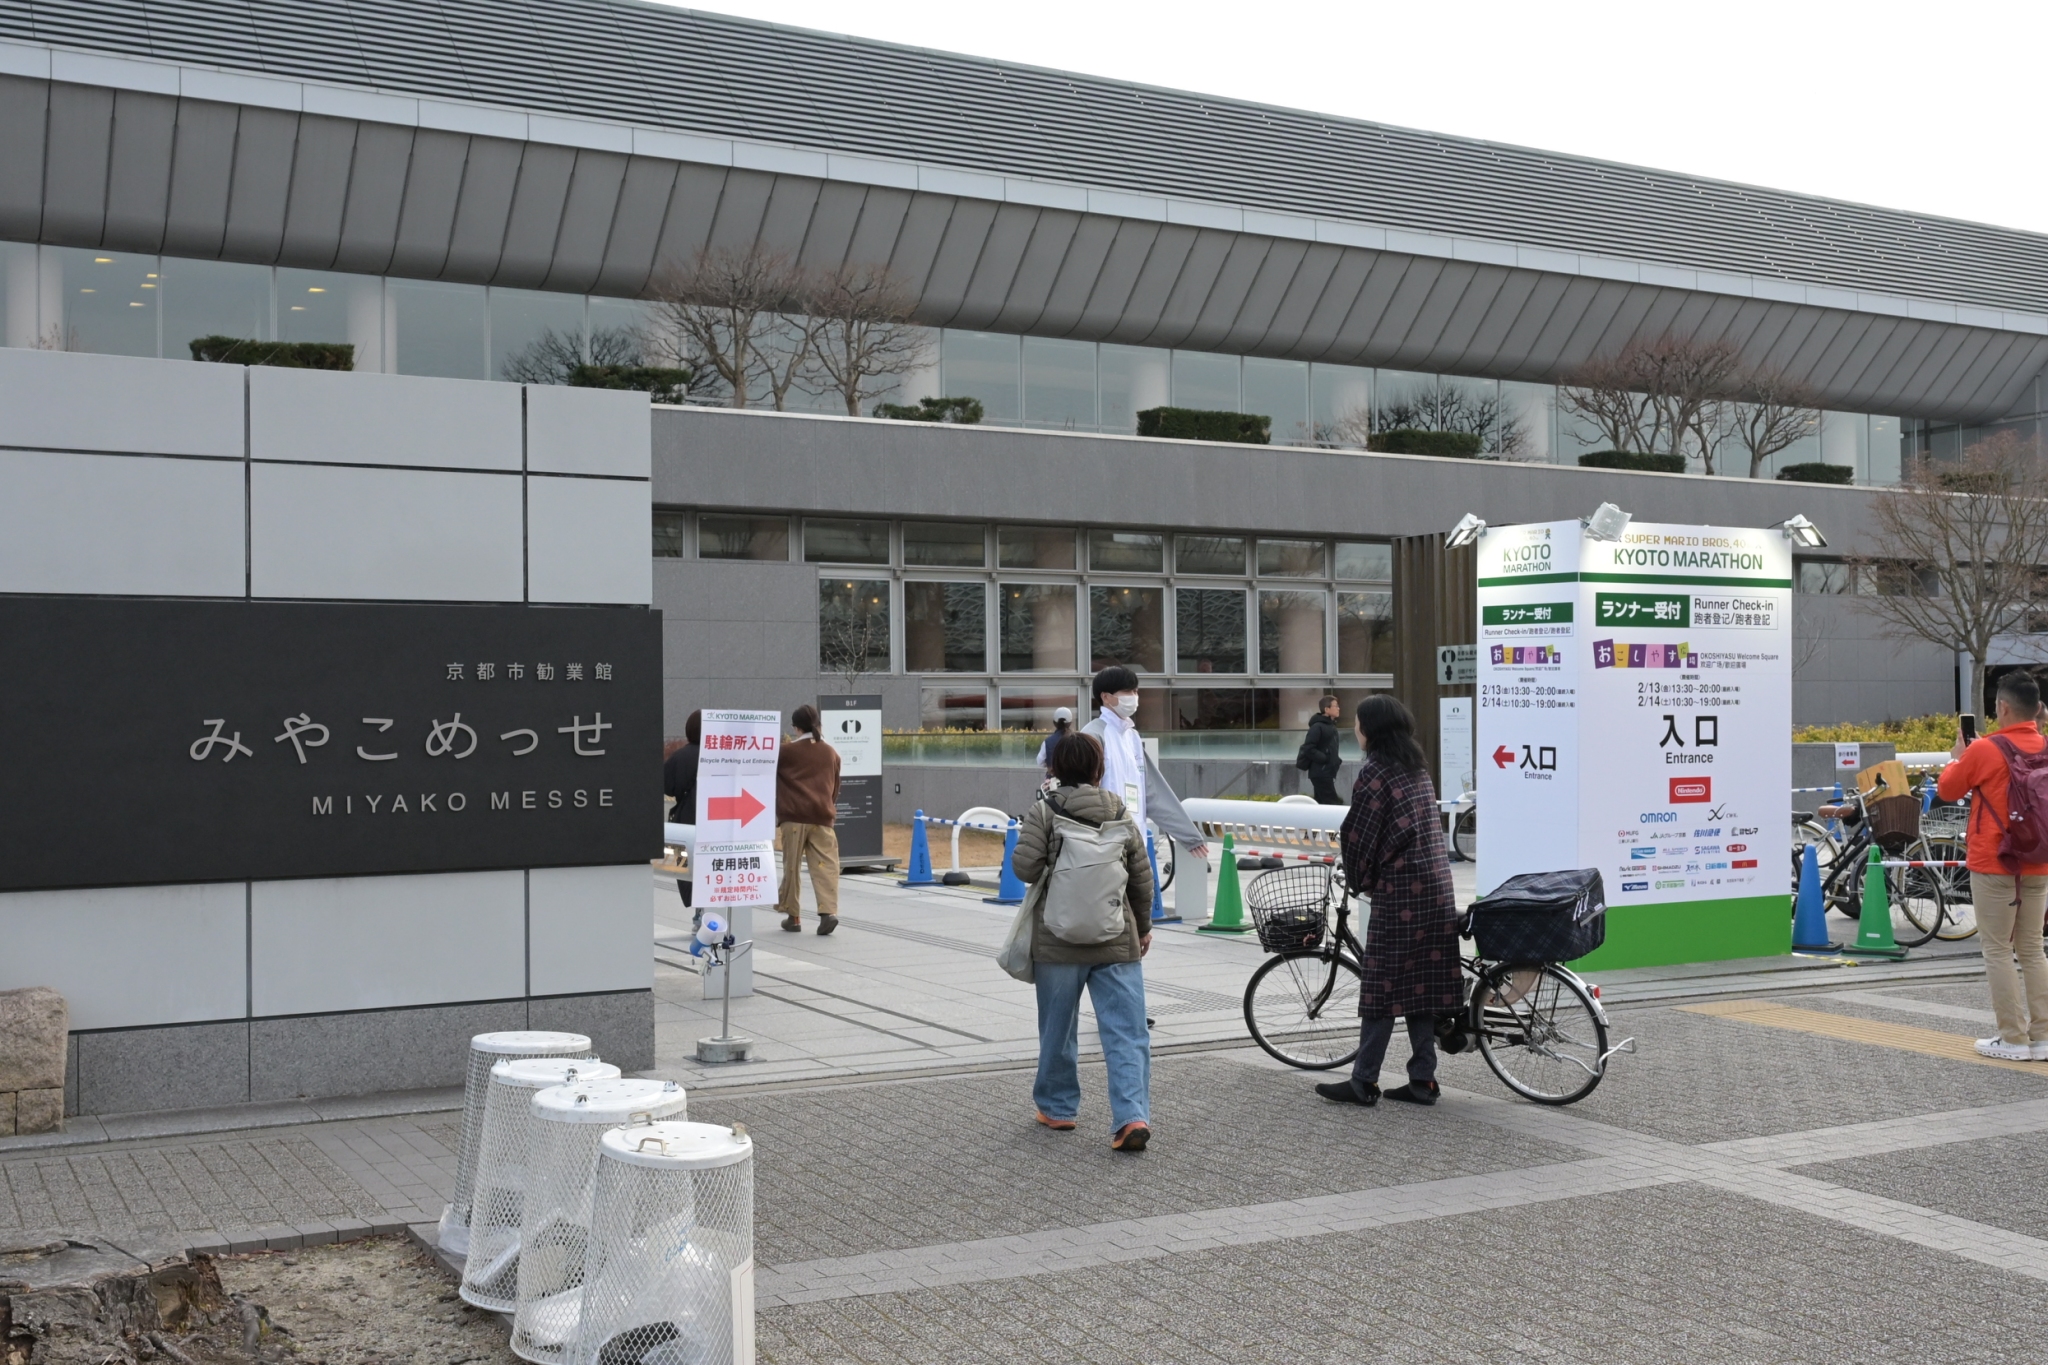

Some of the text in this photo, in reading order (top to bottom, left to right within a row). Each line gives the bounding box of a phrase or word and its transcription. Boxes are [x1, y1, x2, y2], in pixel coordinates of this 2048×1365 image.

[1624, 534, 1660, 545] SUPER
[1664, 535, 1699, 546] MARIO
[1503, 543, 1551, 562] KYOTO
[1614, 548, 1763, 570] KYOTO MARATHON
[1503, 561, 1551, 573] MARATHON
[1602, 601, 1681, 620] ランナー受付
[1694, 597, 1774, 611] Runner Check-in
[1502, 607, 1551, 620] ランナー受付
[1700, 652, 1736, 660] OKOSHIYASU
[1761, 653, 1779, 661] Square
[447, 662, 613, 681] 京都市勧業館
[190, 712, 613, 764] みやこめっせ
[1659, 714, 1718, 748] 入口
[704, 735, 775, 751] 駐輪所入口
[1519, 745, 1557, 771] 入口
[1666, 752, 1714, 764] Entrance
[1524, 771, 1552, 780] Entrance
[313, 789, 613, 815] MIYAKO MESSE
[1640, 812, 1677, 823] OMRON
[734, 843, 768, 851] MARATHON
[711, 857, 761, 871] 使用時間
